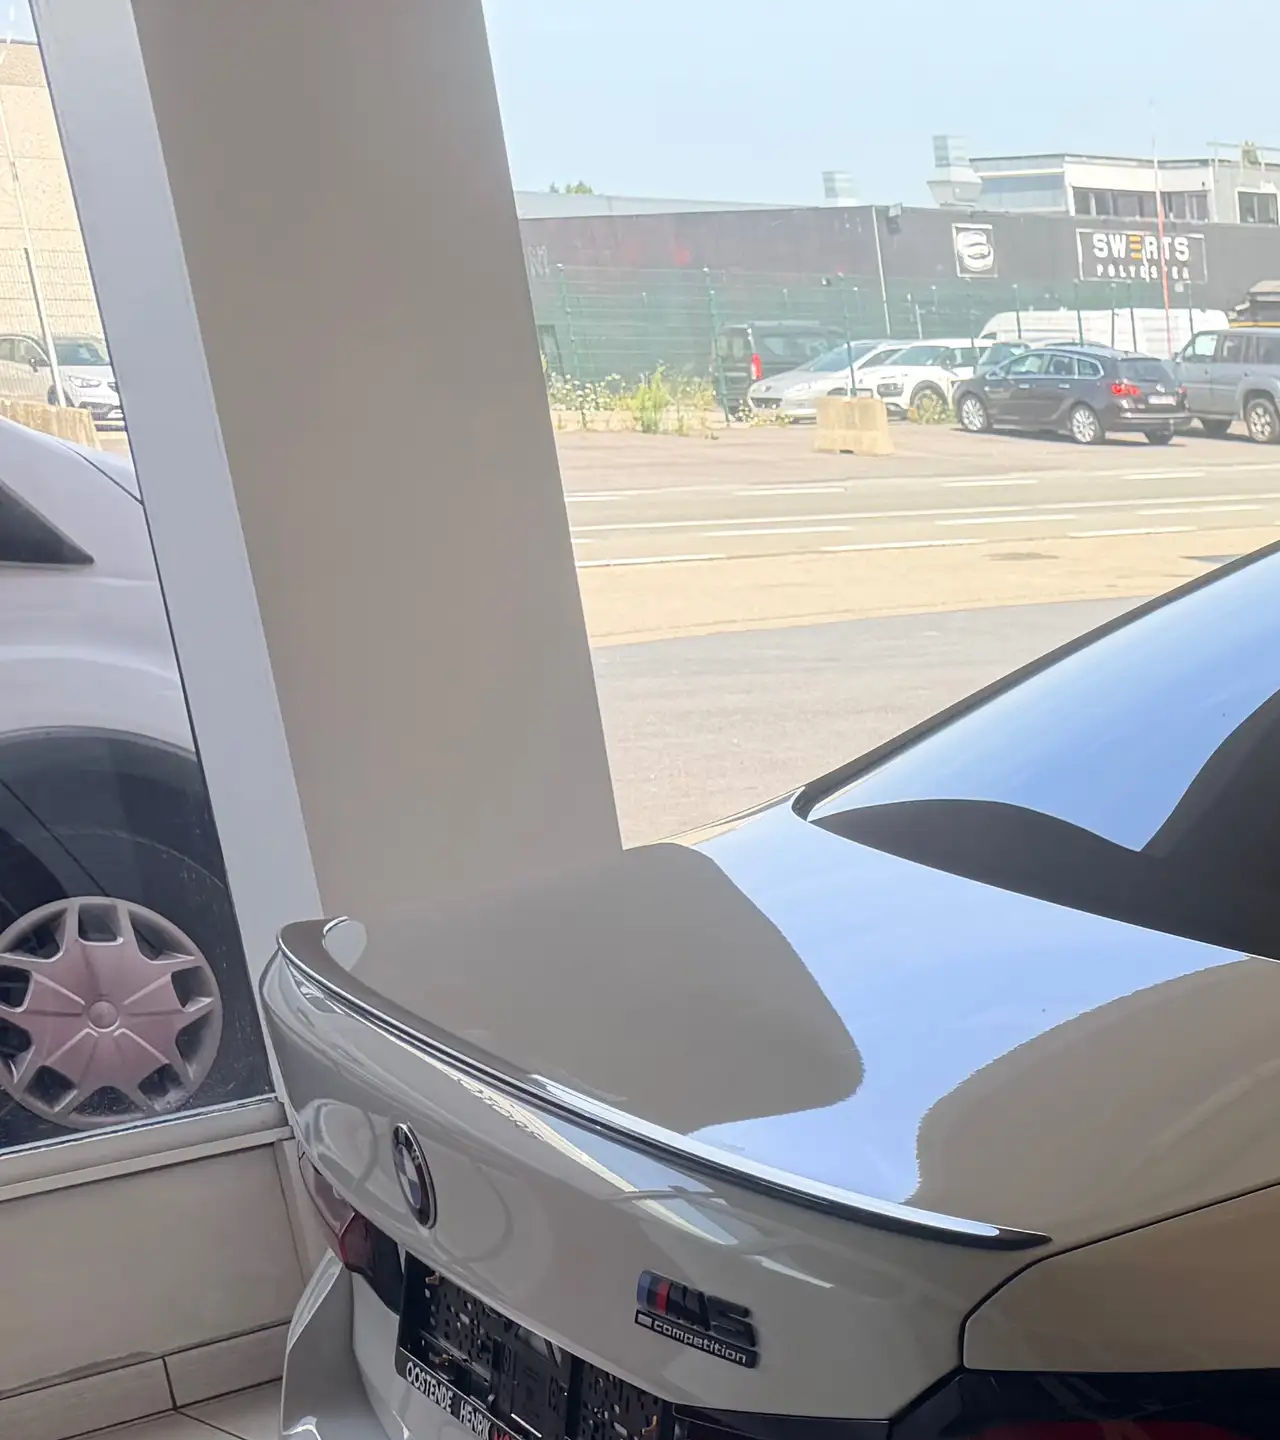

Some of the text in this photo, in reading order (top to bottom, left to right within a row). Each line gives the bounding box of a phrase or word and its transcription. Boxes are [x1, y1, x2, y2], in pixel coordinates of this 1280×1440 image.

[1092, 233, 1190, 262] SWERTS
[1096, 263, 1190, 280] POLYESER
[652, 1319, 747, 1364] competition
[405, 1361, 453, 1413] OOSTENDE
